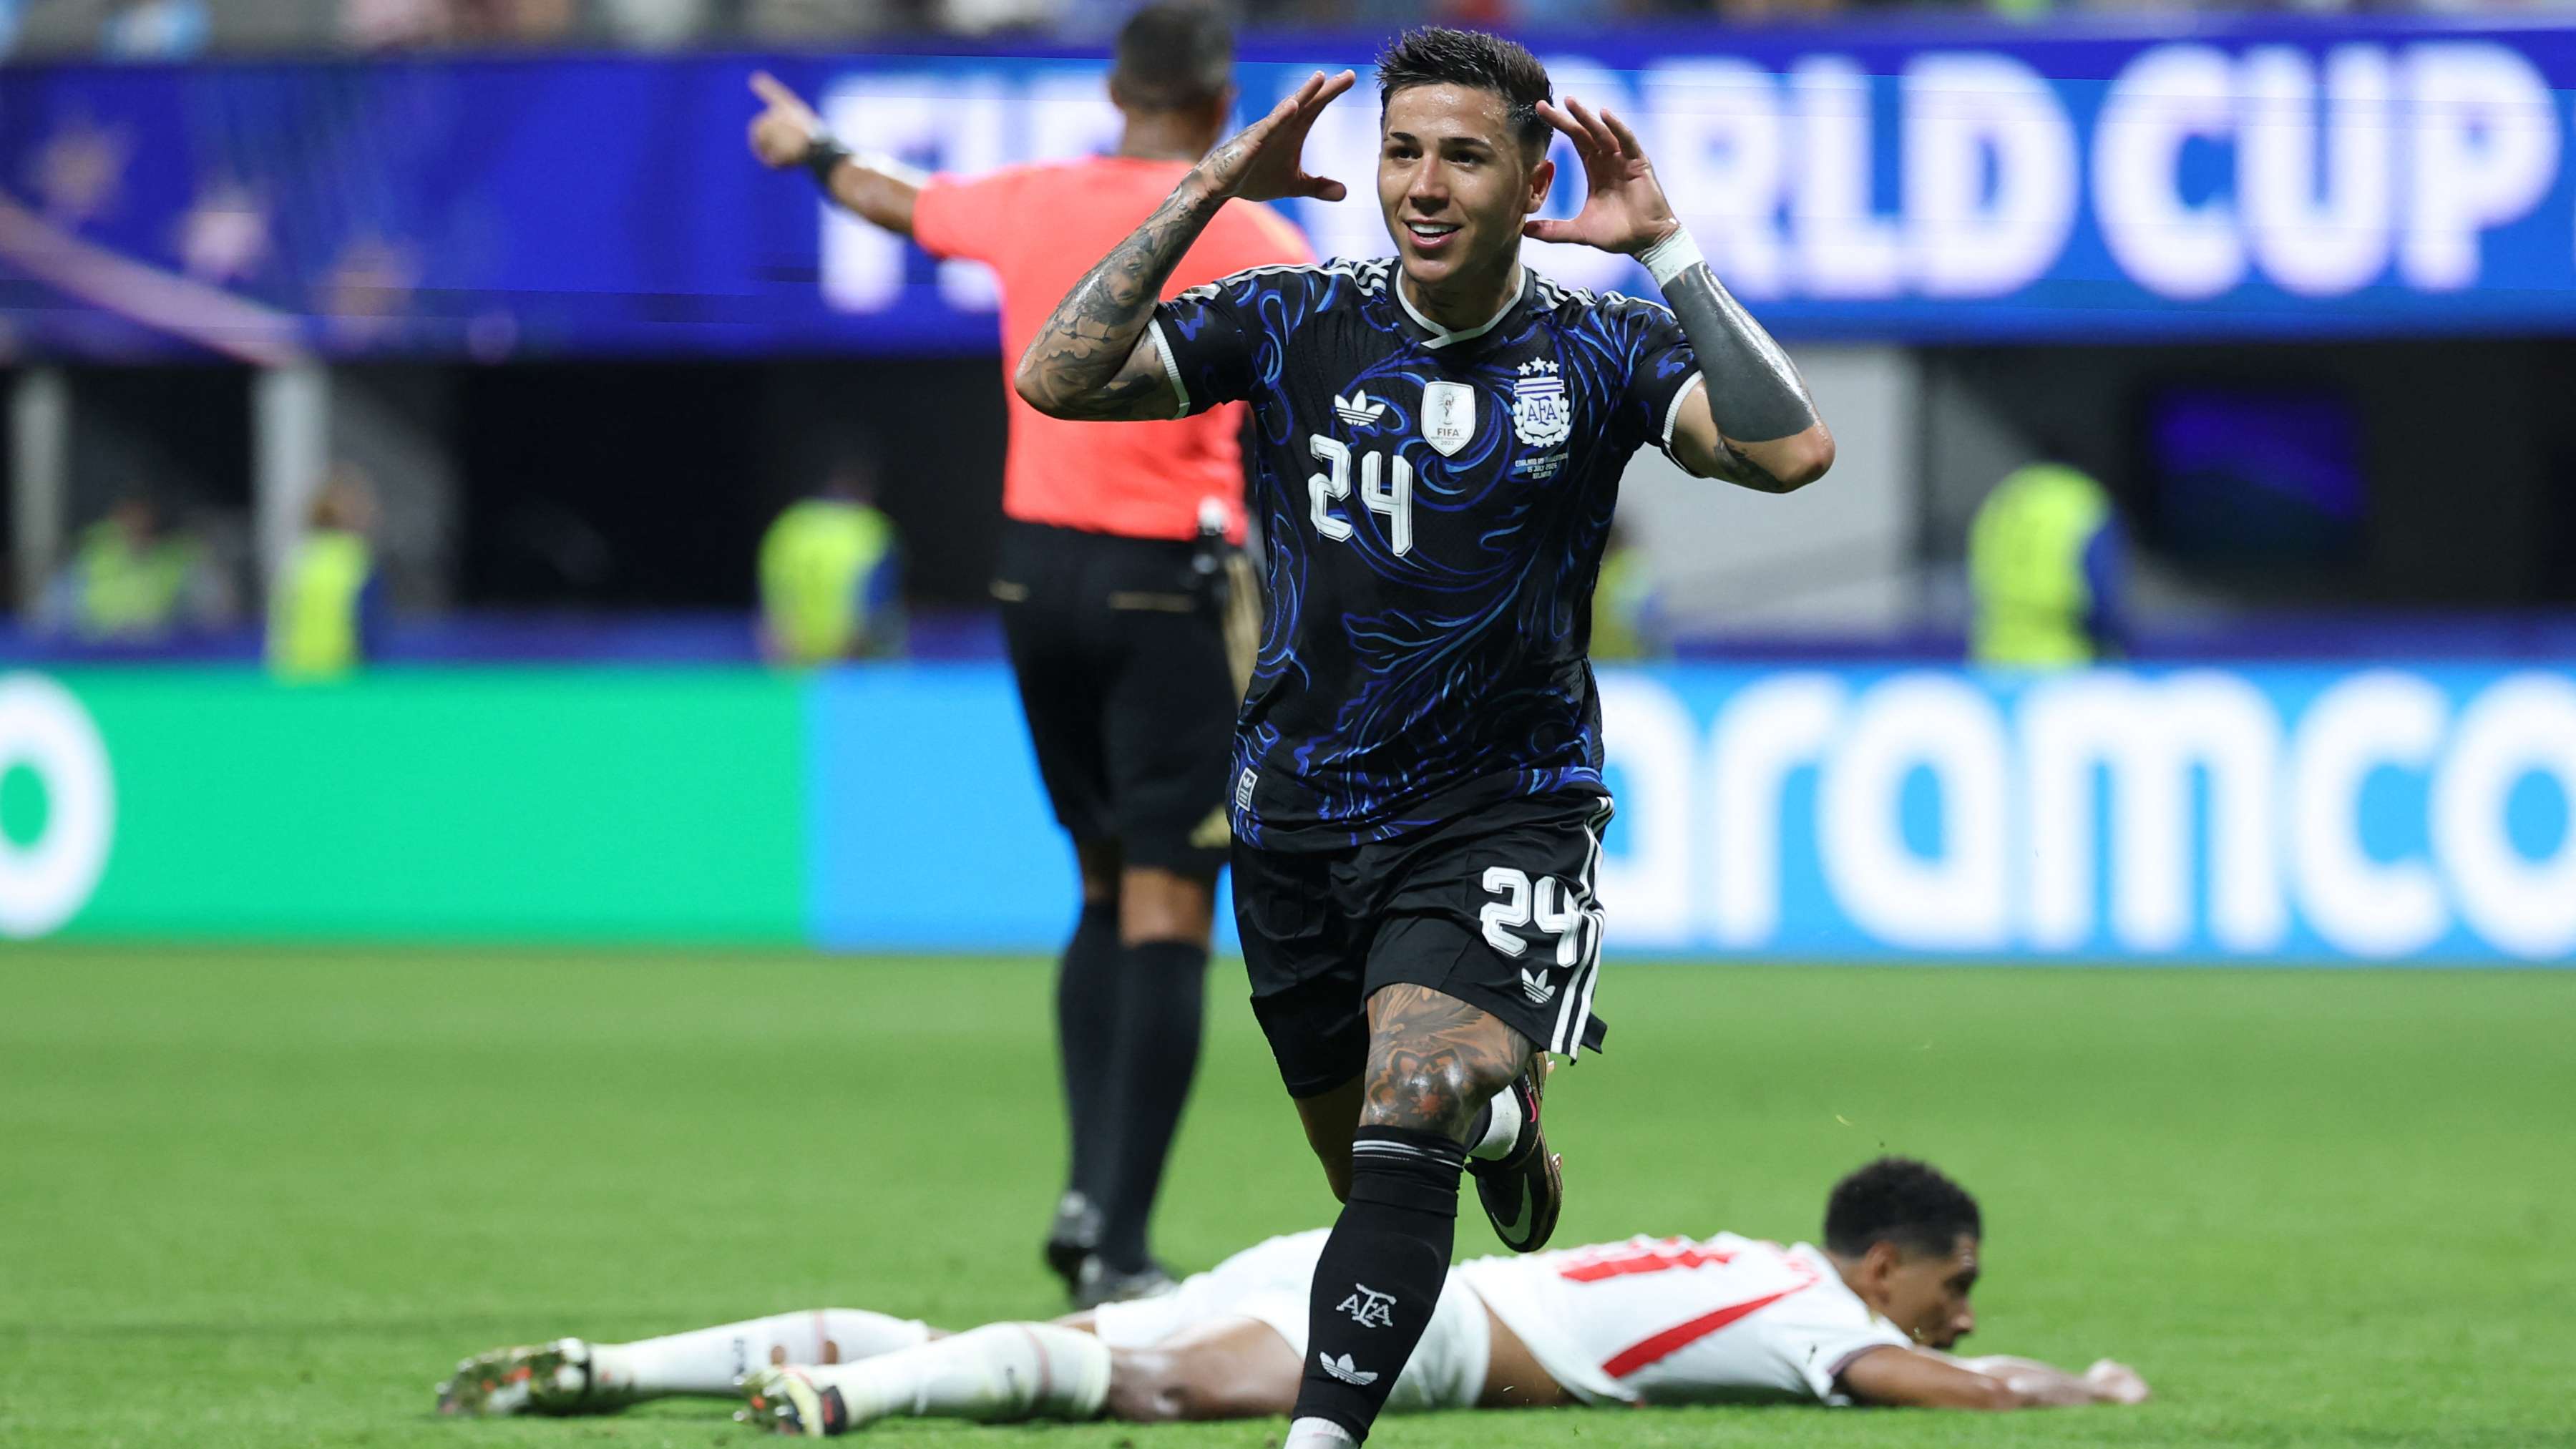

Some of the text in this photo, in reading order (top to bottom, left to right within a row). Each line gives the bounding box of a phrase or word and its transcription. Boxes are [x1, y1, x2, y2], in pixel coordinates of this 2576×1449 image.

[818, 42, 2562, 315] FI RLD CUP
[1437, 428, 1459, 436] FIFA
[1526, 396, 1558, 426] AFA
[1308, 434, 1413, 557] 24
[1480, 867, 1582, 968] 24
[1336, 1283, 1397, 1329] AFA
